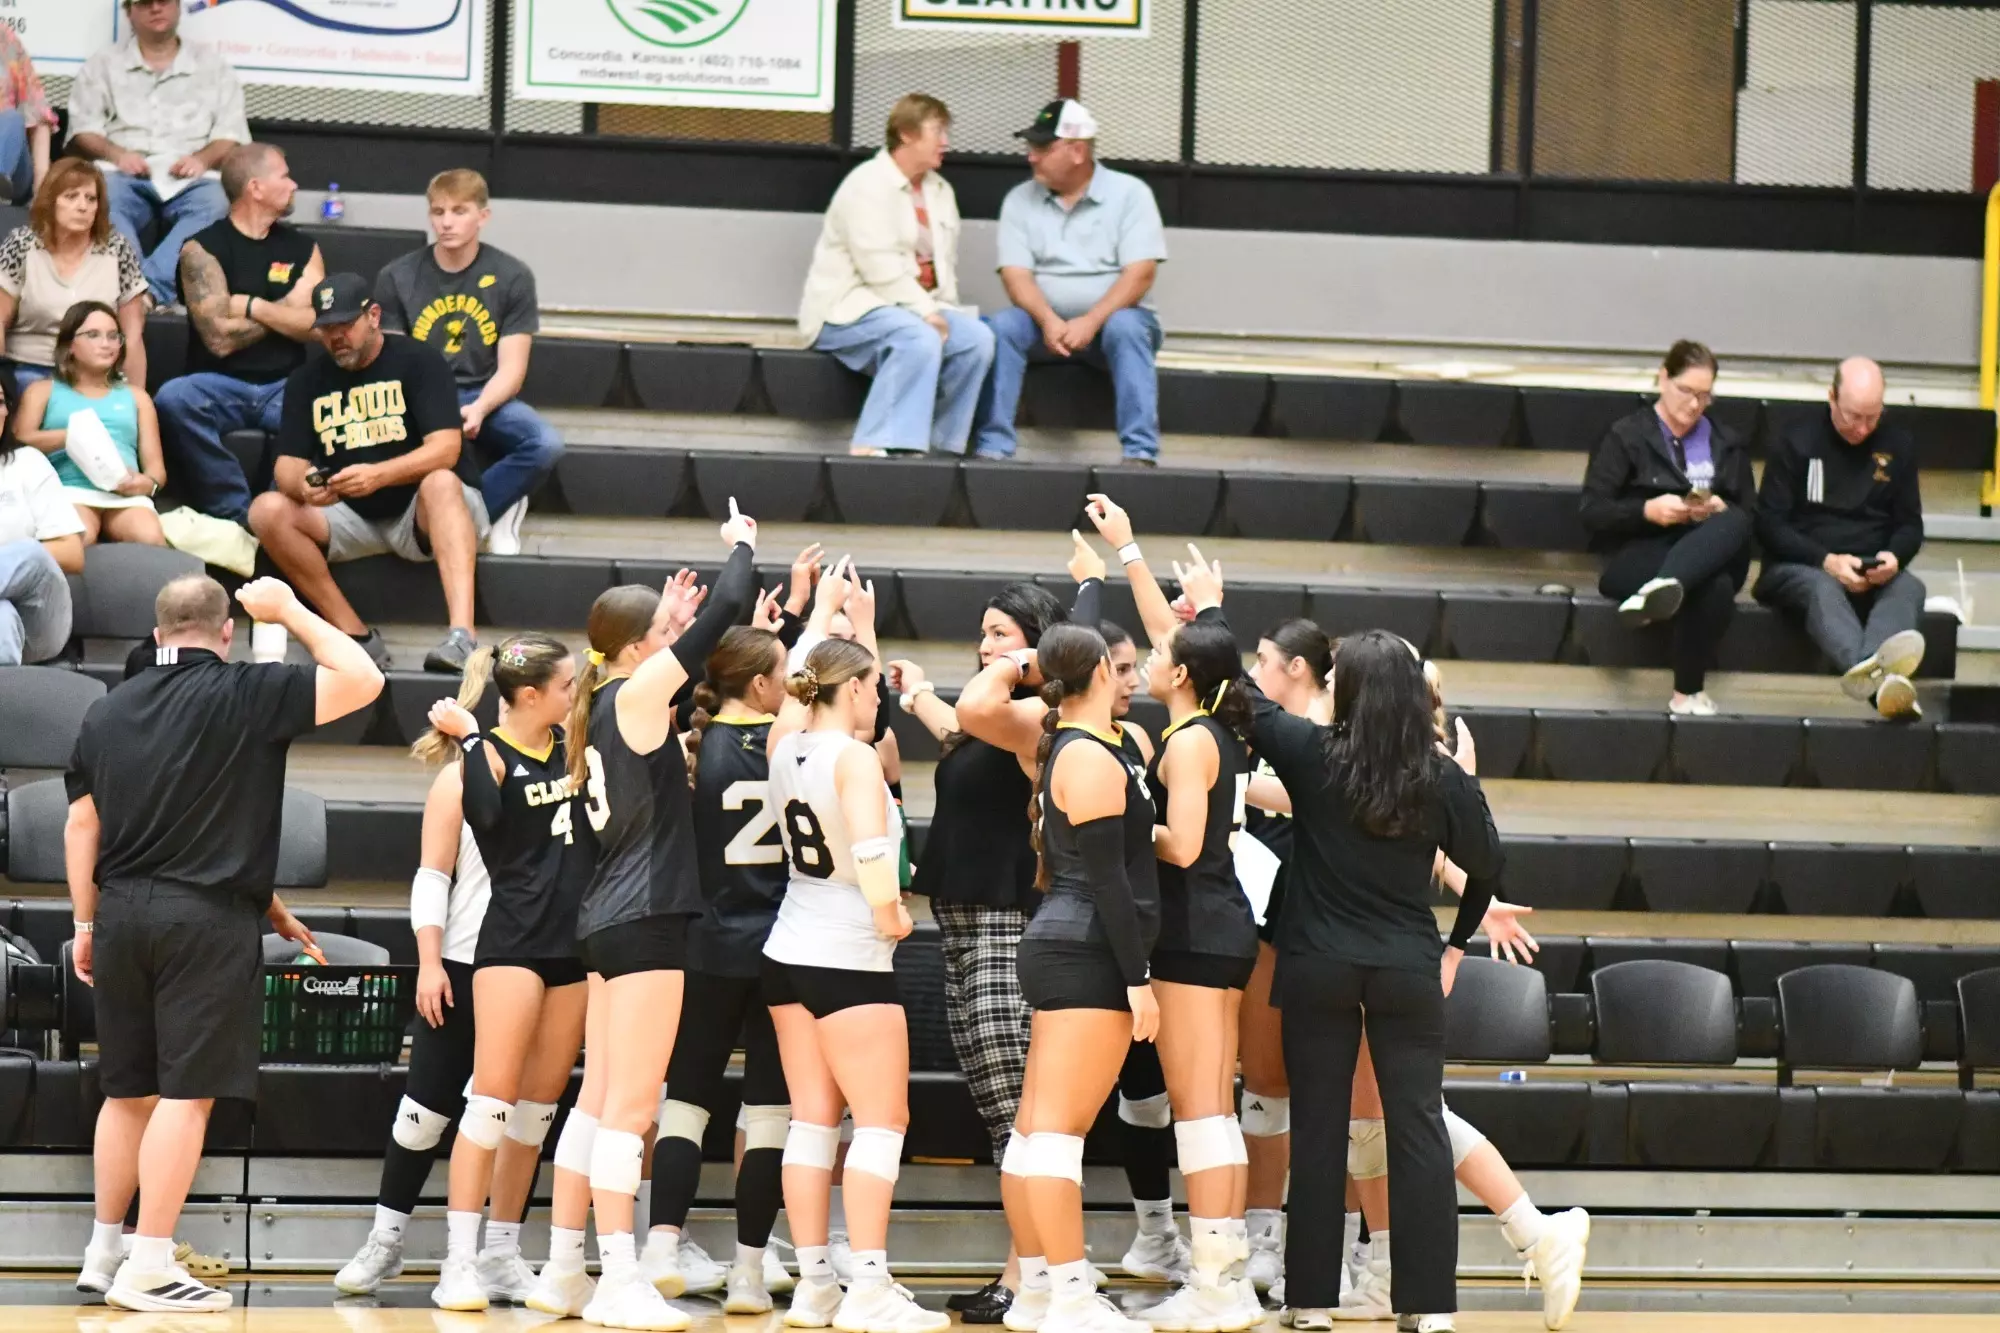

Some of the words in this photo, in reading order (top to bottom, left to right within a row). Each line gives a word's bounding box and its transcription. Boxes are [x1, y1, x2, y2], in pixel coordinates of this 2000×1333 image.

[632, 51, 684, 64] Kansas
[313, 380, 407, 433] CLOUD
[320, 415, 408, 456] T-BIRDS
[550, 801, 574, 845] 4
[722, 780, 783, 865] 2
[785, 798, 835, 879] 8
